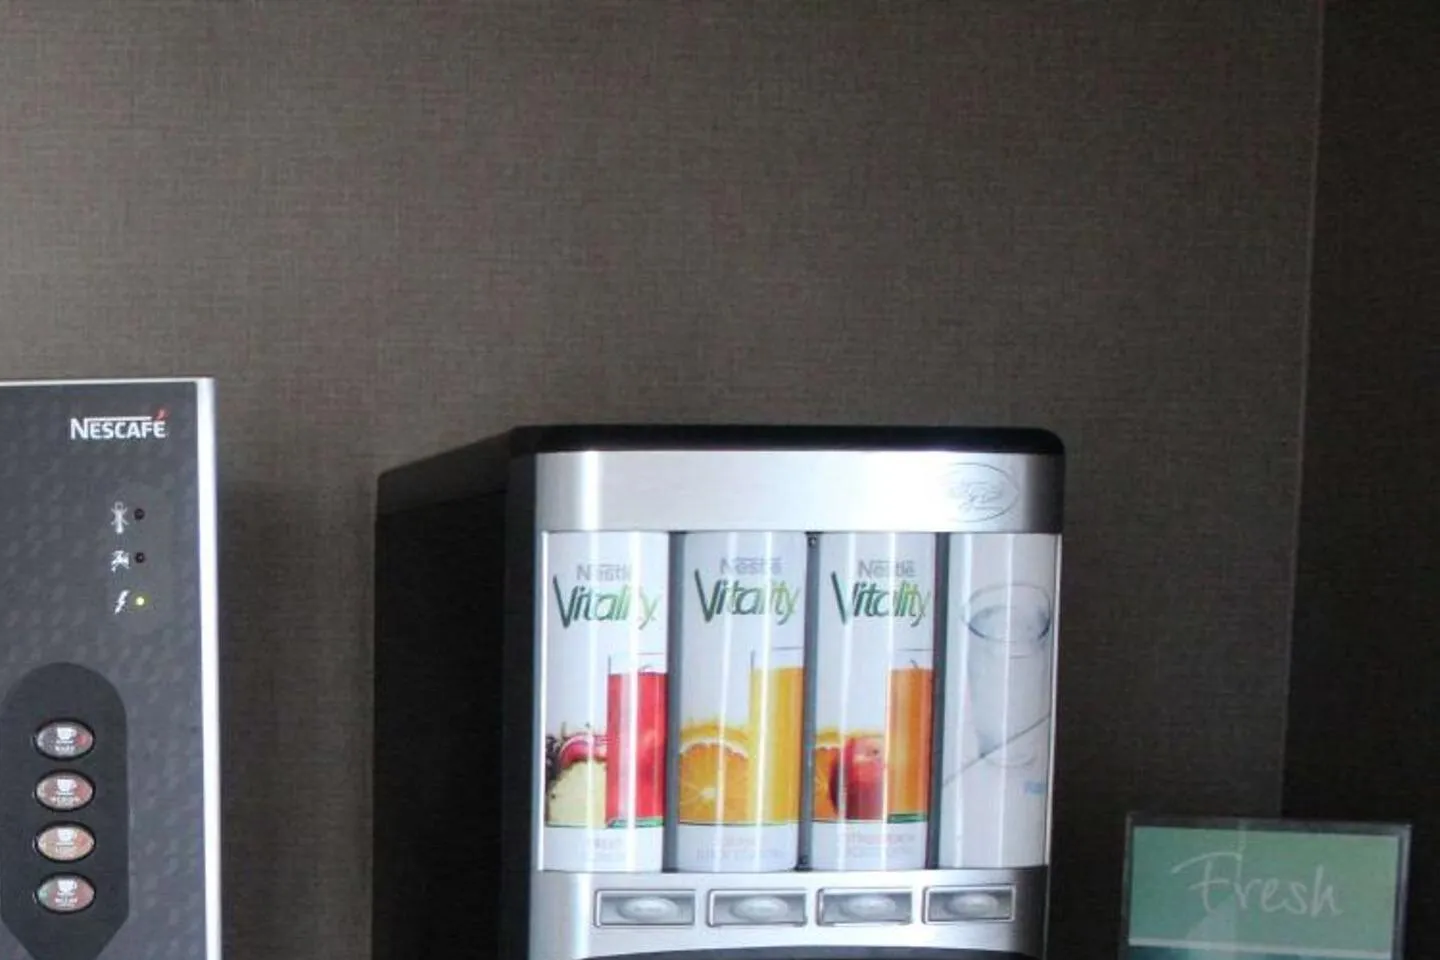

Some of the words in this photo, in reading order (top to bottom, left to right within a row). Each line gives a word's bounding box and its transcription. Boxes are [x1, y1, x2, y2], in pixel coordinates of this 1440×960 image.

[70, 409, 166, 440] NESCAFÉ
[695, 568, 800, 625] Vitality
[858, 559, 917, 578] Netlé
[553, 575, 658, 630] Vitaliy
[830, 570, 931, 627] Vitality
[1171, 851, 1344, 918] Fresh
